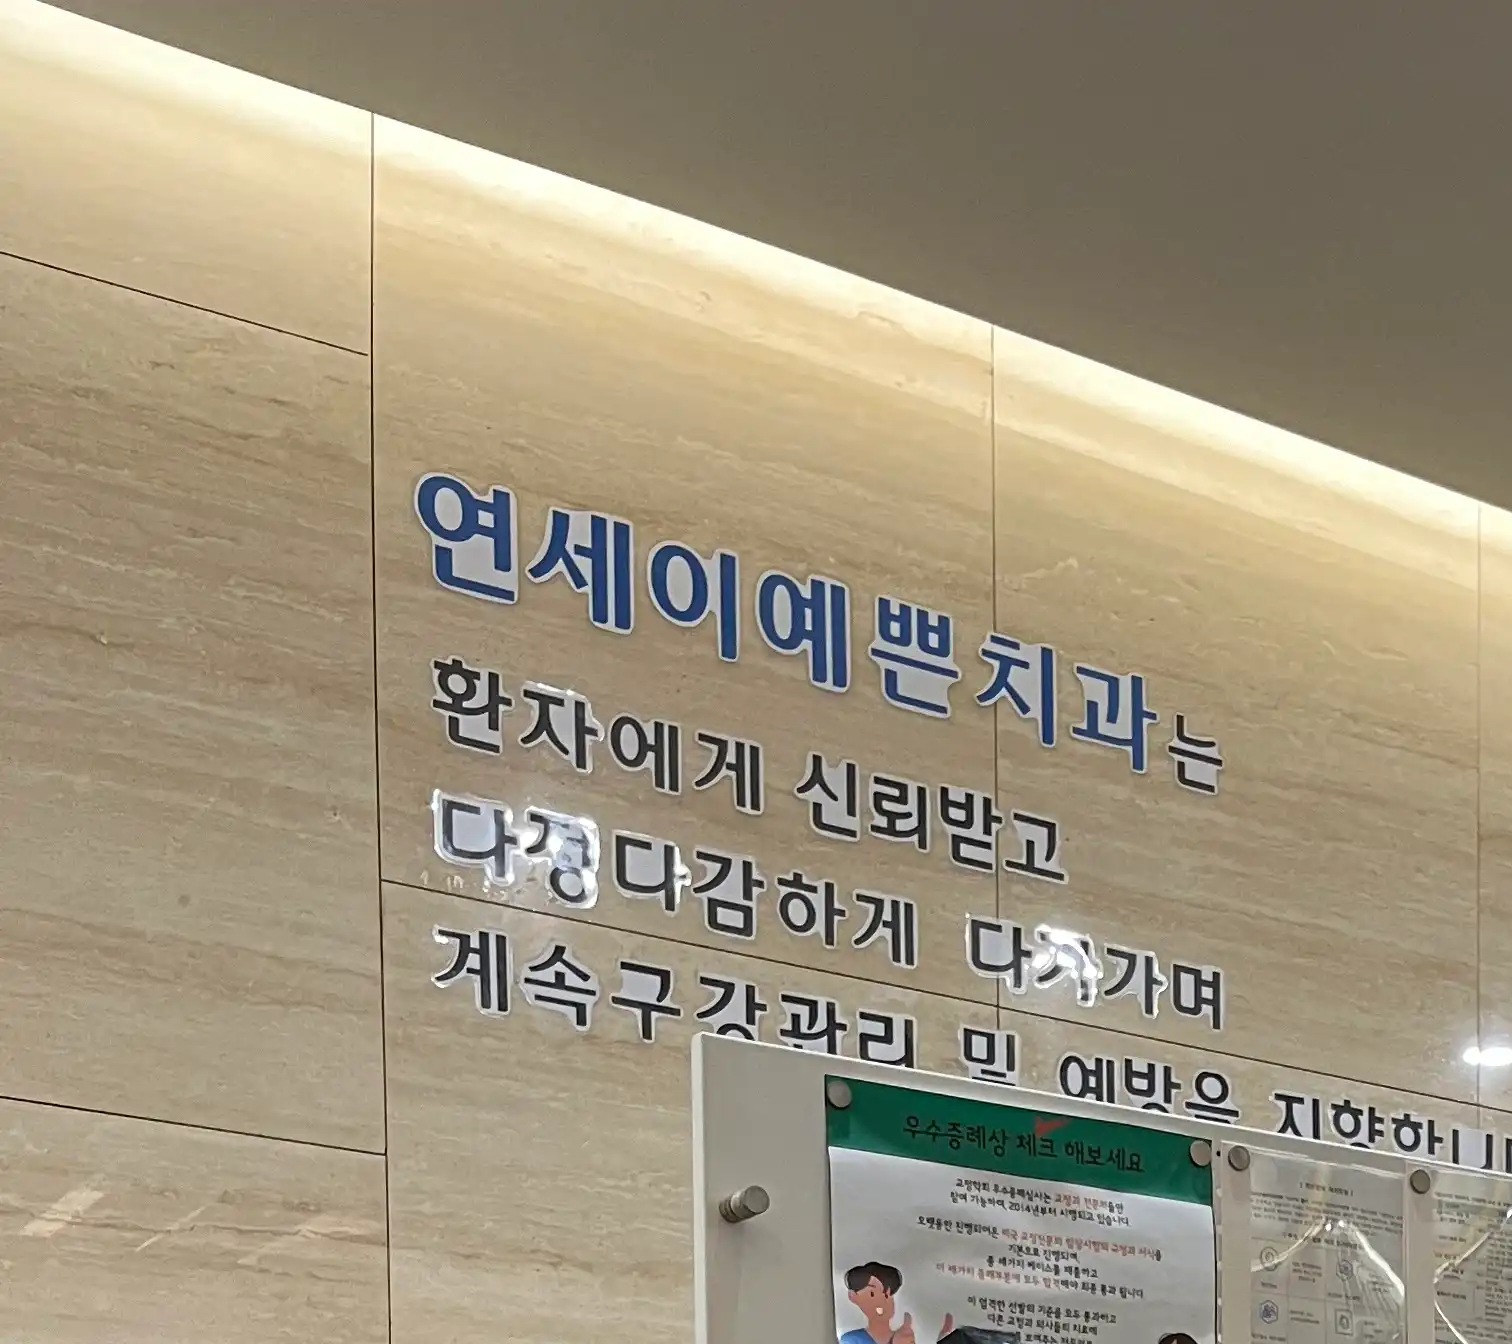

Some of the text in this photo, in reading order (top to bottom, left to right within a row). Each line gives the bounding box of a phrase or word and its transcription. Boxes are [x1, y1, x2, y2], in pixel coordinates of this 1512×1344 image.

[415, 472, 1223, 794] 연세이예쁜치과는
[433, 656, 1066, 882] 환자에게 신뢰받고
[903, 1115, 1144, 1172] 우수증례상 체크 해보세요
